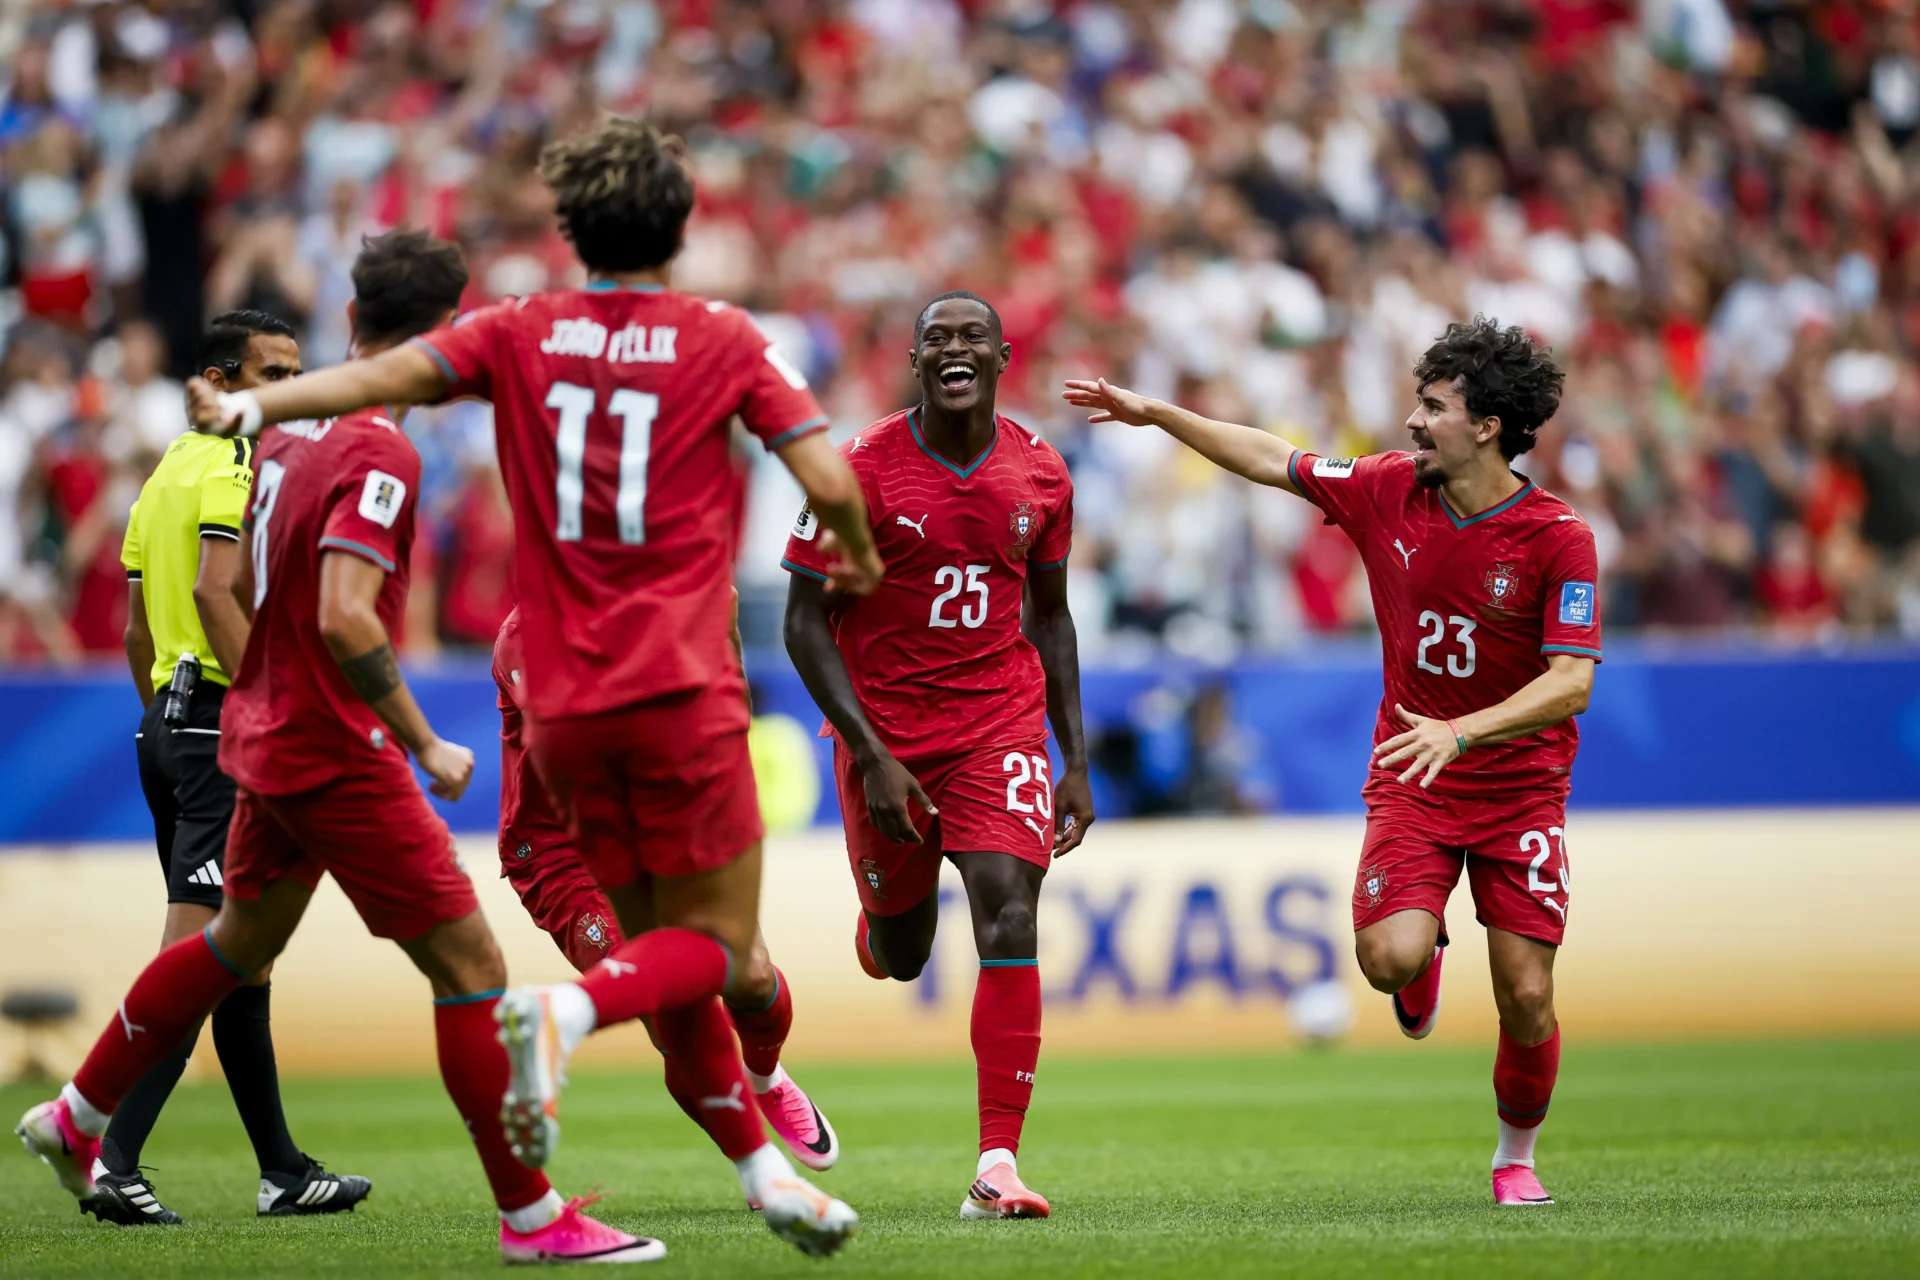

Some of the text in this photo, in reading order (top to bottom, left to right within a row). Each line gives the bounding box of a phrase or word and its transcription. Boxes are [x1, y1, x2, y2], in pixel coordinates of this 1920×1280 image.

[545, 381, 660, 546] 11
[928, 564, 991, 628] 25
[1569, 608, 1587, 617] PEACE
[1417, 609, 1477, 678] 23
[1002, 751, 1052, 820] 25
[918, 878, 1338, 1006] TXAS
